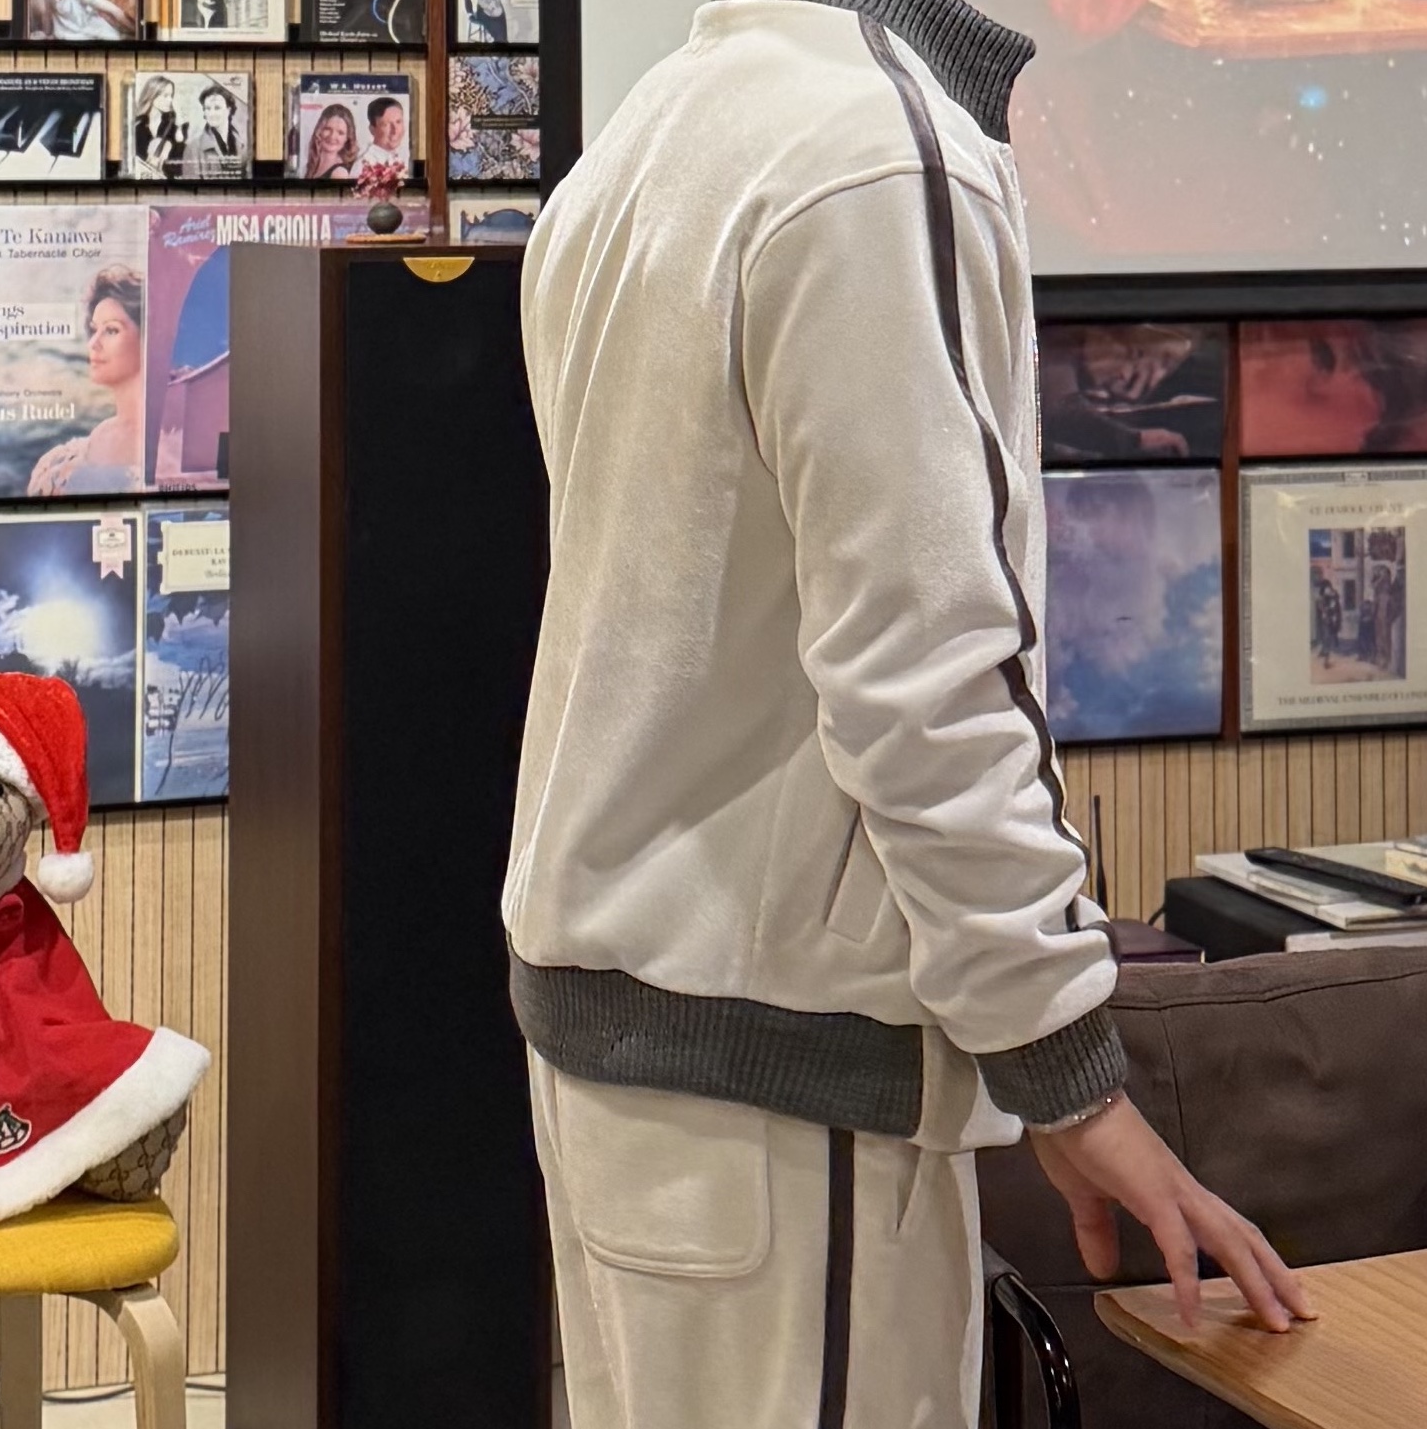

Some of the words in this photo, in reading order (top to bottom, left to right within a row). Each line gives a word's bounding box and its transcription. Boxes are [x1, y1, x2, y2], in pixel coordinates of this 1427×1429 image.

[0, 228, 22, 245] Te
[28, 228, 103, 245] Kanawa
[217, 213, 259, 246] MISA
[264, 214, 332, 245] CRIOLLA
[8, 248, 67, 259] Tabernacle
[72, 248, 101, 258] Choir
[22, 403, 75, 421] Rudel
